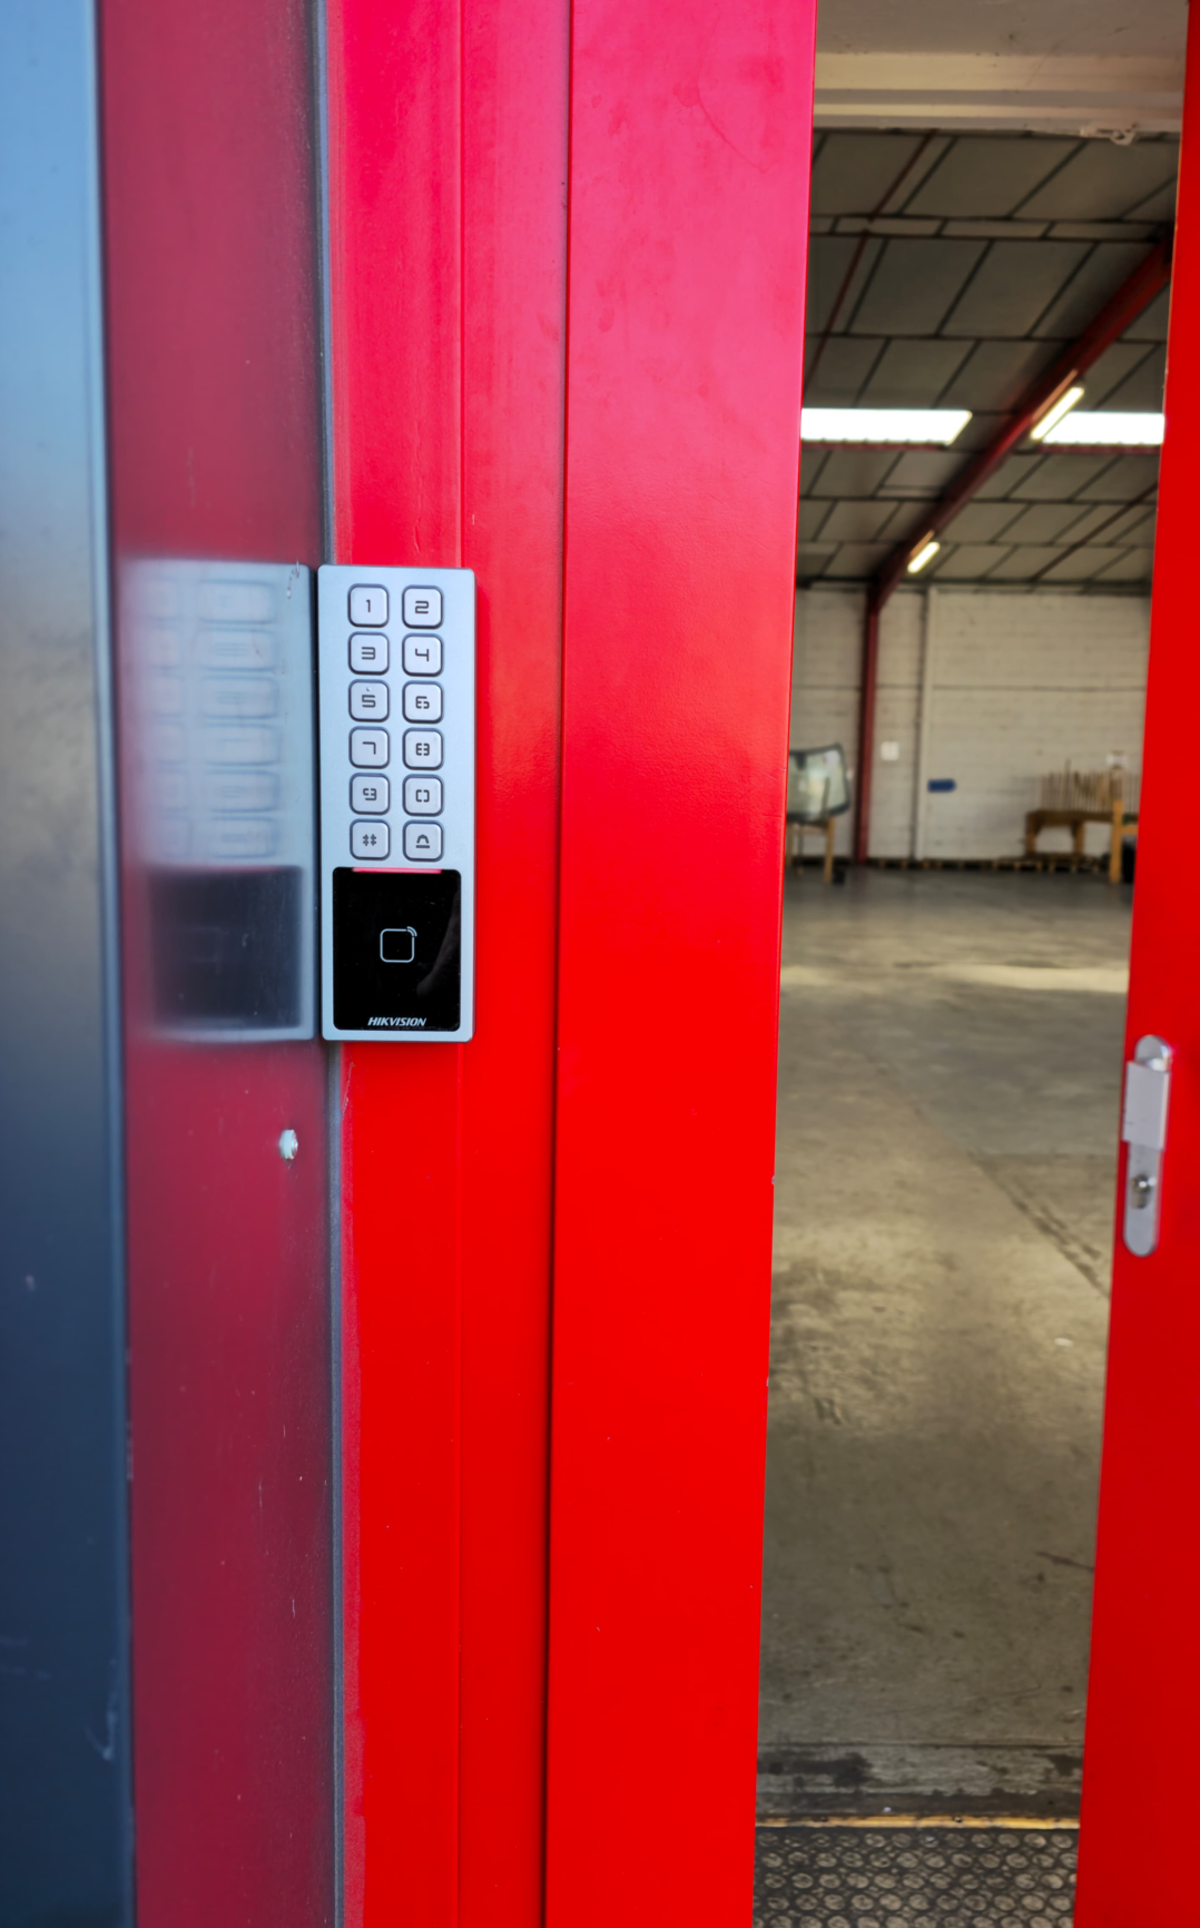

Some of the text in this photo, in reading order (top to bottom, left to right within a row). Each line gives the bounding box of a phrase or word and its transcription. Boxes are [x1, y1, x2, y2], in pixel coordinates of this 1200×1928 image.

[365, 599, 372, 613] 1
[414, 600, 430, 614] 2
[361, 646, 376, 660] 3
[414, 648, 430, 662] 4
[361, 694, 377, 708] 5
[415, 695, 430, 710] 6
[362, 741, 377, 755] 7
[415, 742, 430, 756] 8
[362, 787, 378, 801] 9
[415, 789, 430, 803] 0
[367, 1016, 427, 1027] HIKVISION
